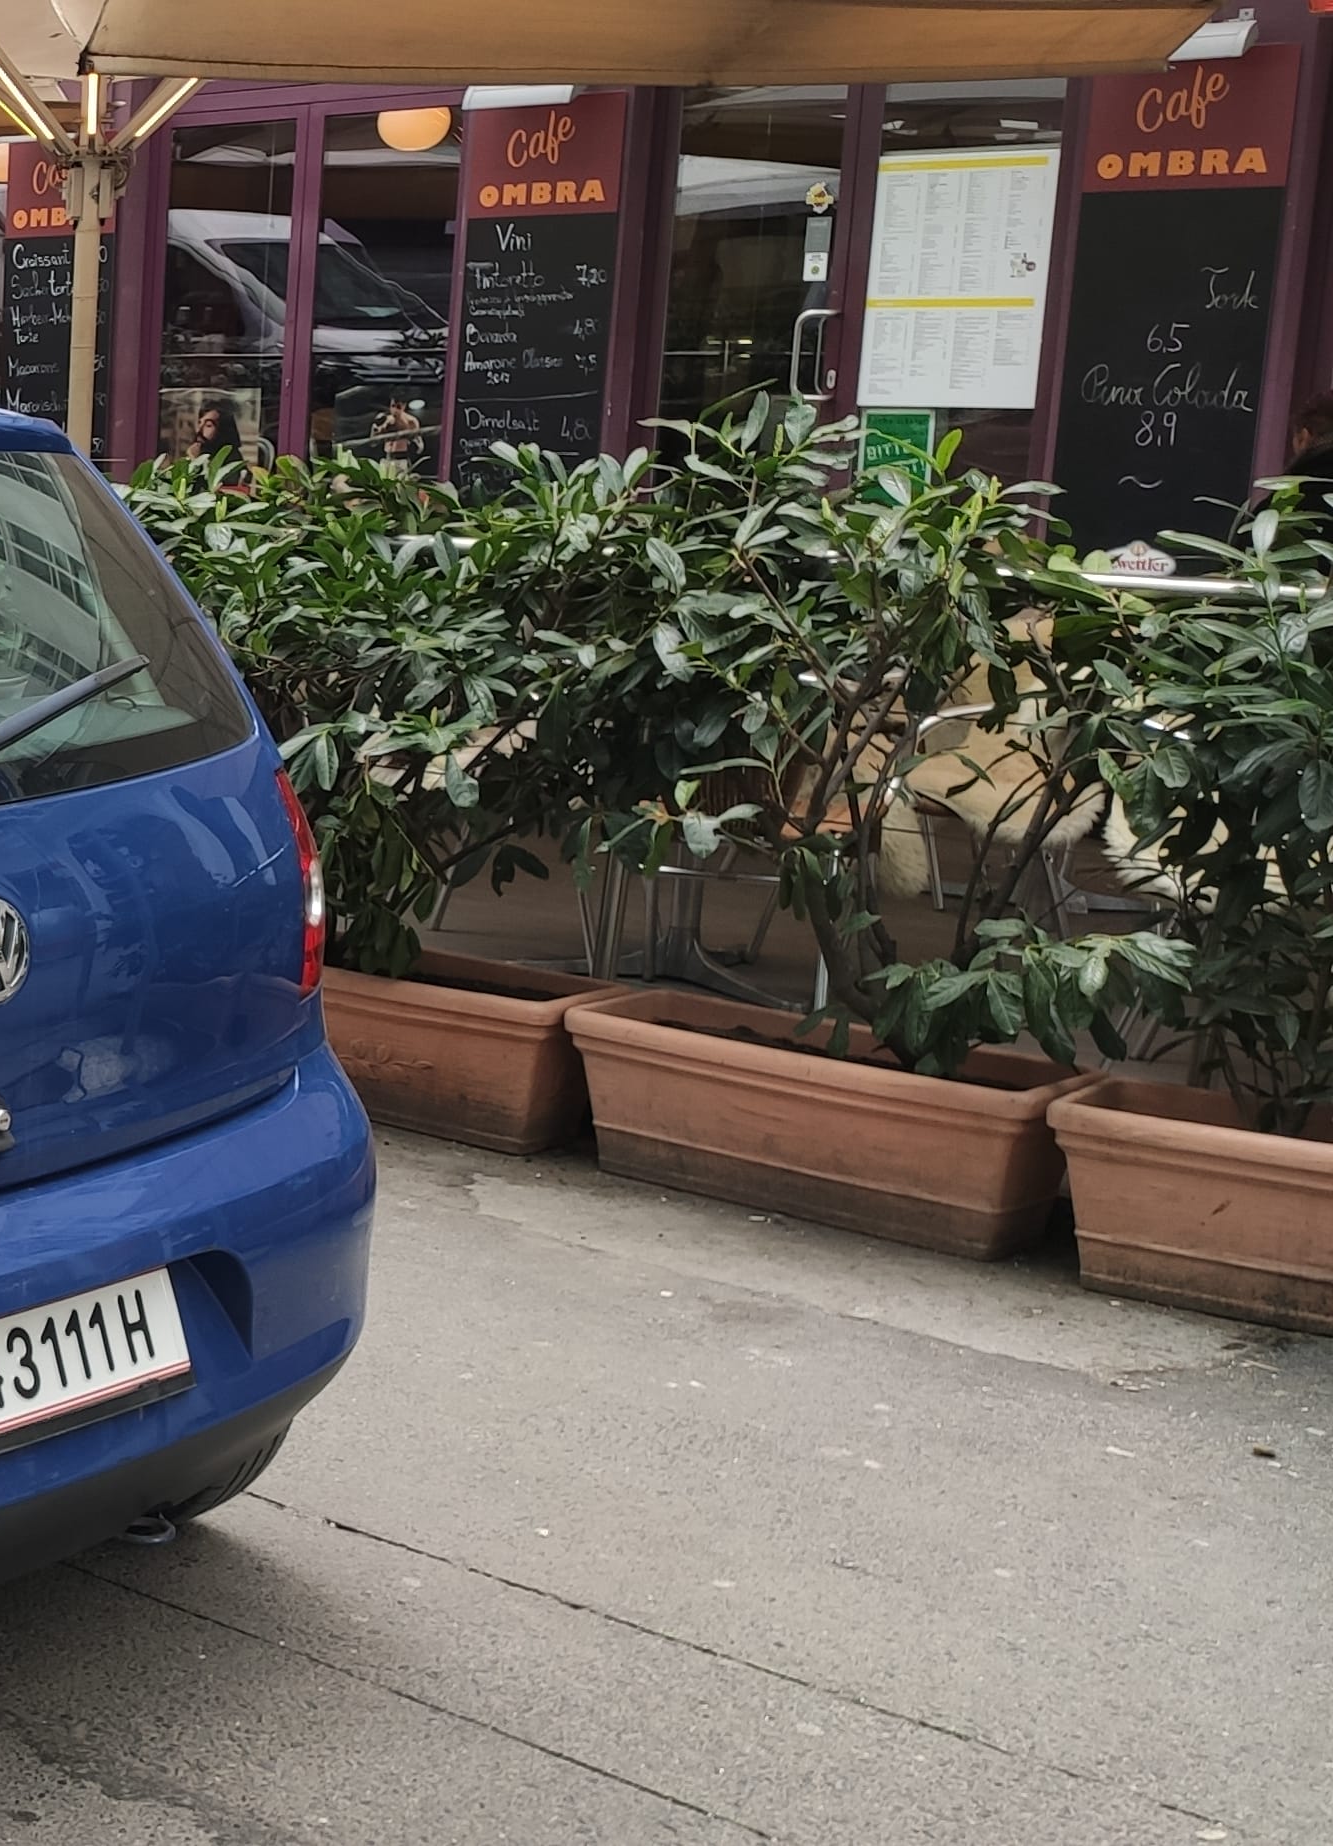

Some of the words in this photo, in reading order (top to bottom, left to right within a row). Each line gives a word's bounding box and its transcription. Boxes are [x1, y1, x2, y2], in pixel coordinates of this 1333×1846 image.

[1136, 65, 1230, 133] Cafe
[507, 110, 575, 168] Cafe
[33, 161, 69, 194] Ca
[1097, 147, 1268, 180] OMBRA
[479, 179, 605, 208] OMBRA
[13, 207, 74, 229] OMB
[495, 223, 532, 251] Vini
[12, 243, 71, 269] Croissant
[1146, 322, 1190, 353] 6,5
[1152, 361, 1254, 413] Colada
[1134, 410, 1178, 447] 8,9
[1114, 557, 1169, 572] wettler
